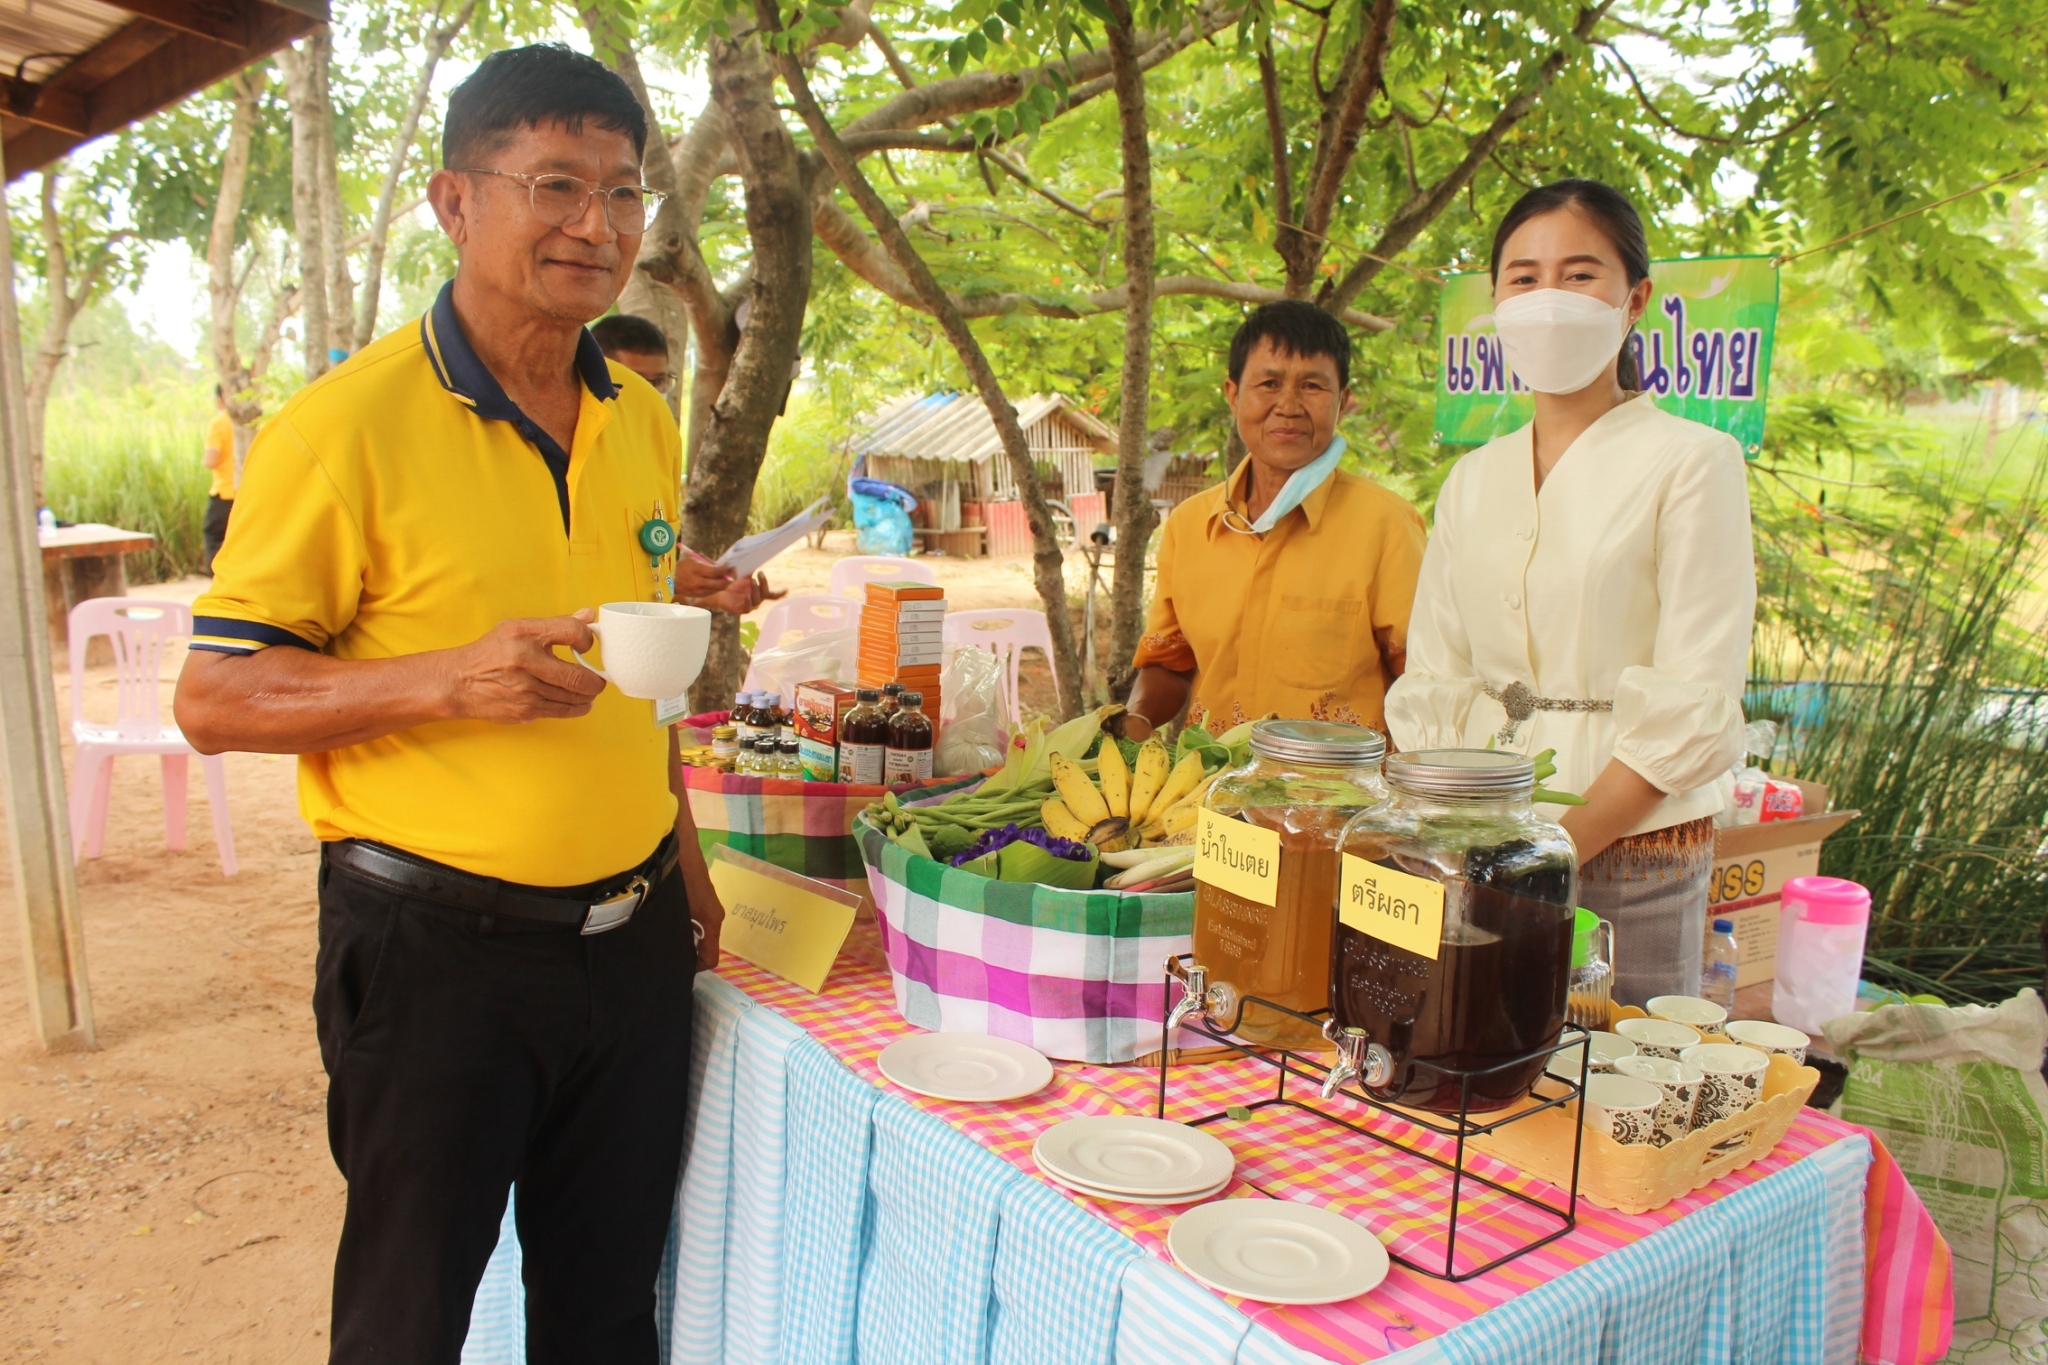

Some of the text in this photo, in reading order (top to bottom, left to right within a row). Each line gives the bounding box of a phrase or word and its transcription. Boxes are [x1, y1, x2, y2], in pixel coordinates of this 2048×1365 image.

[1201, 821, 1270, 879] น้ำใบเตย
[731, 902, 788, 935] ยาสมุนไพร
[1351, 877, 1421, 926] ตรีผลา
[1849, 1060, 1884, 1089] 204
[2029, 1140, 2042, 1186] BROILER
